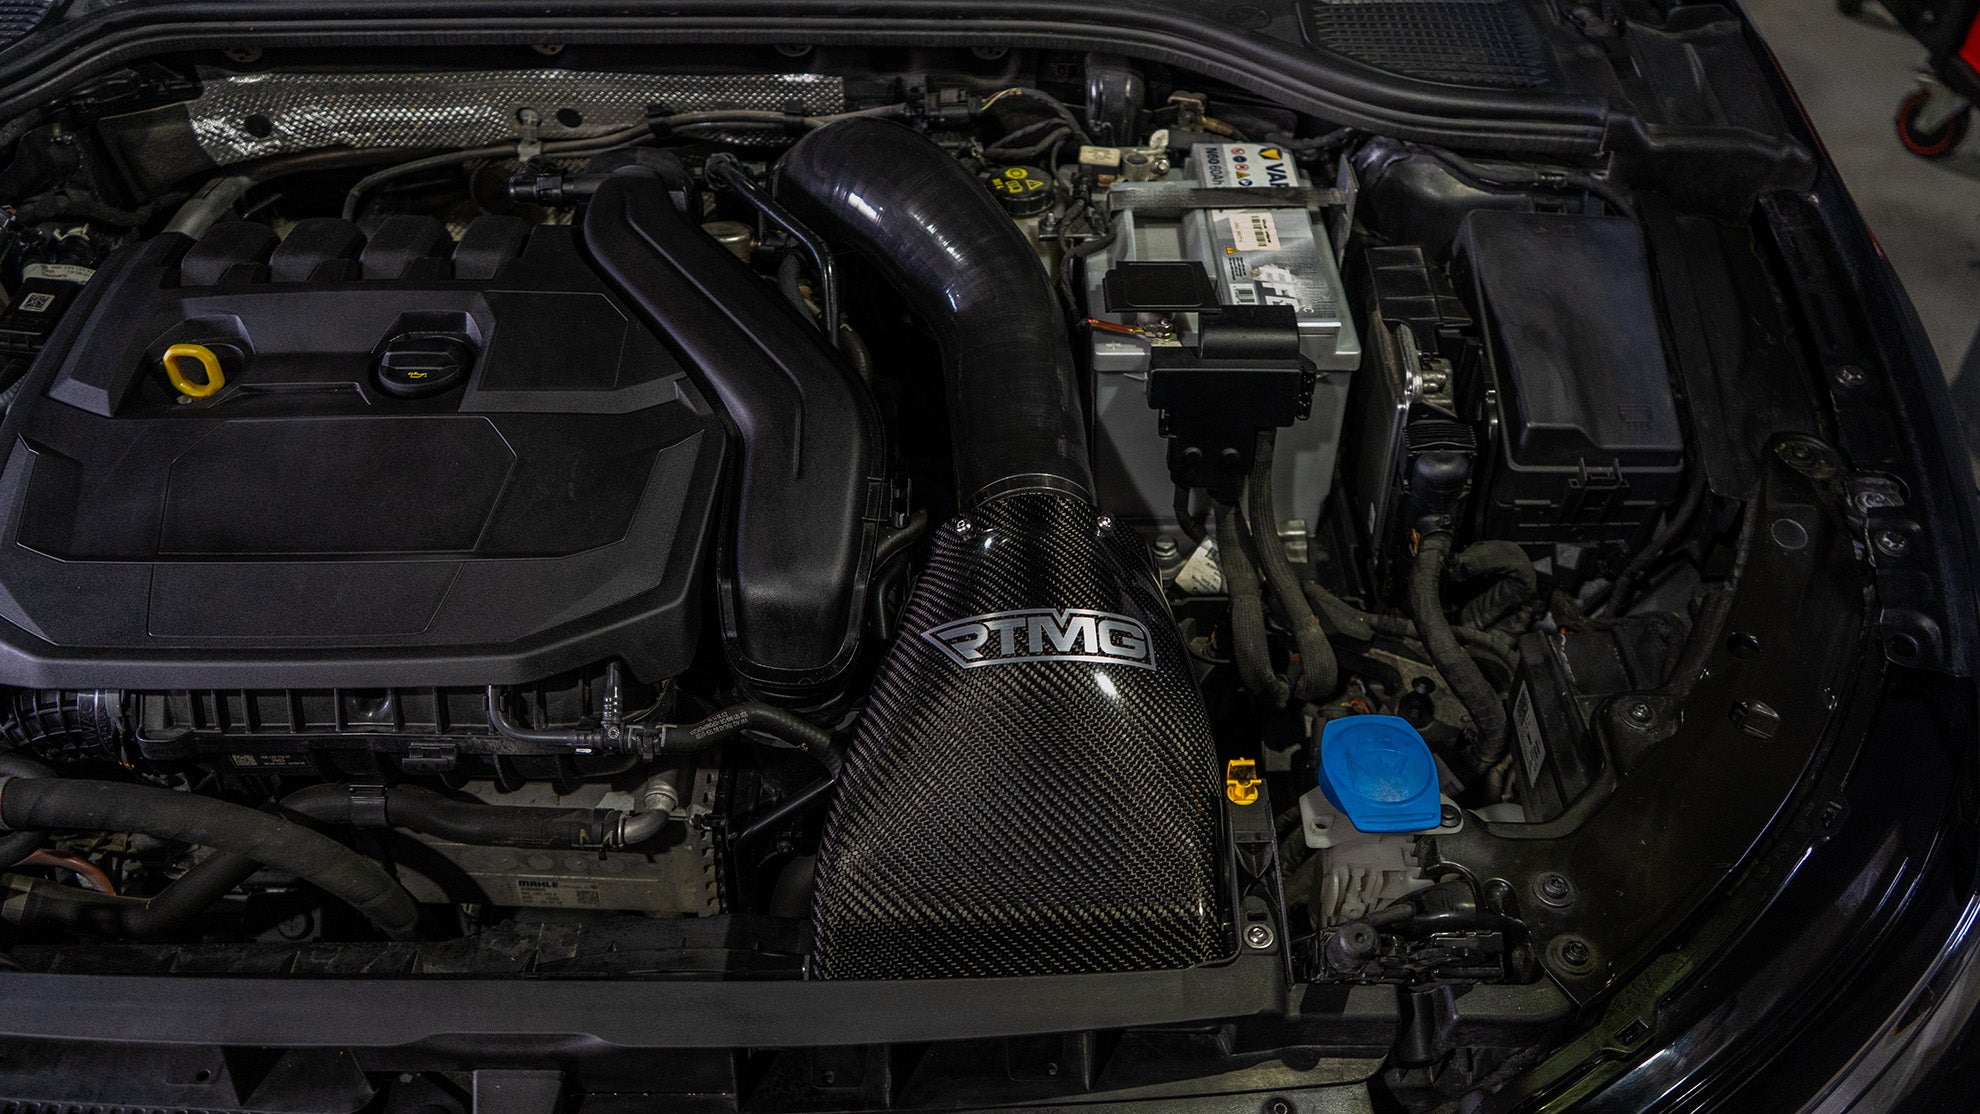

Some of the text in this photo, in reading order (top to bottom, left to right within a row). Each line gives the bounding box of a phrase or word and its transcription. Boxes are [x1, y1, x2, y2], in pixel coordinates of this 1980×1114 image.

[1206, 147, 1225, 185] N60 60Ah
[937, 616, 1146, 660] RTMG
[518, 880, 559, 888] MAHLE
